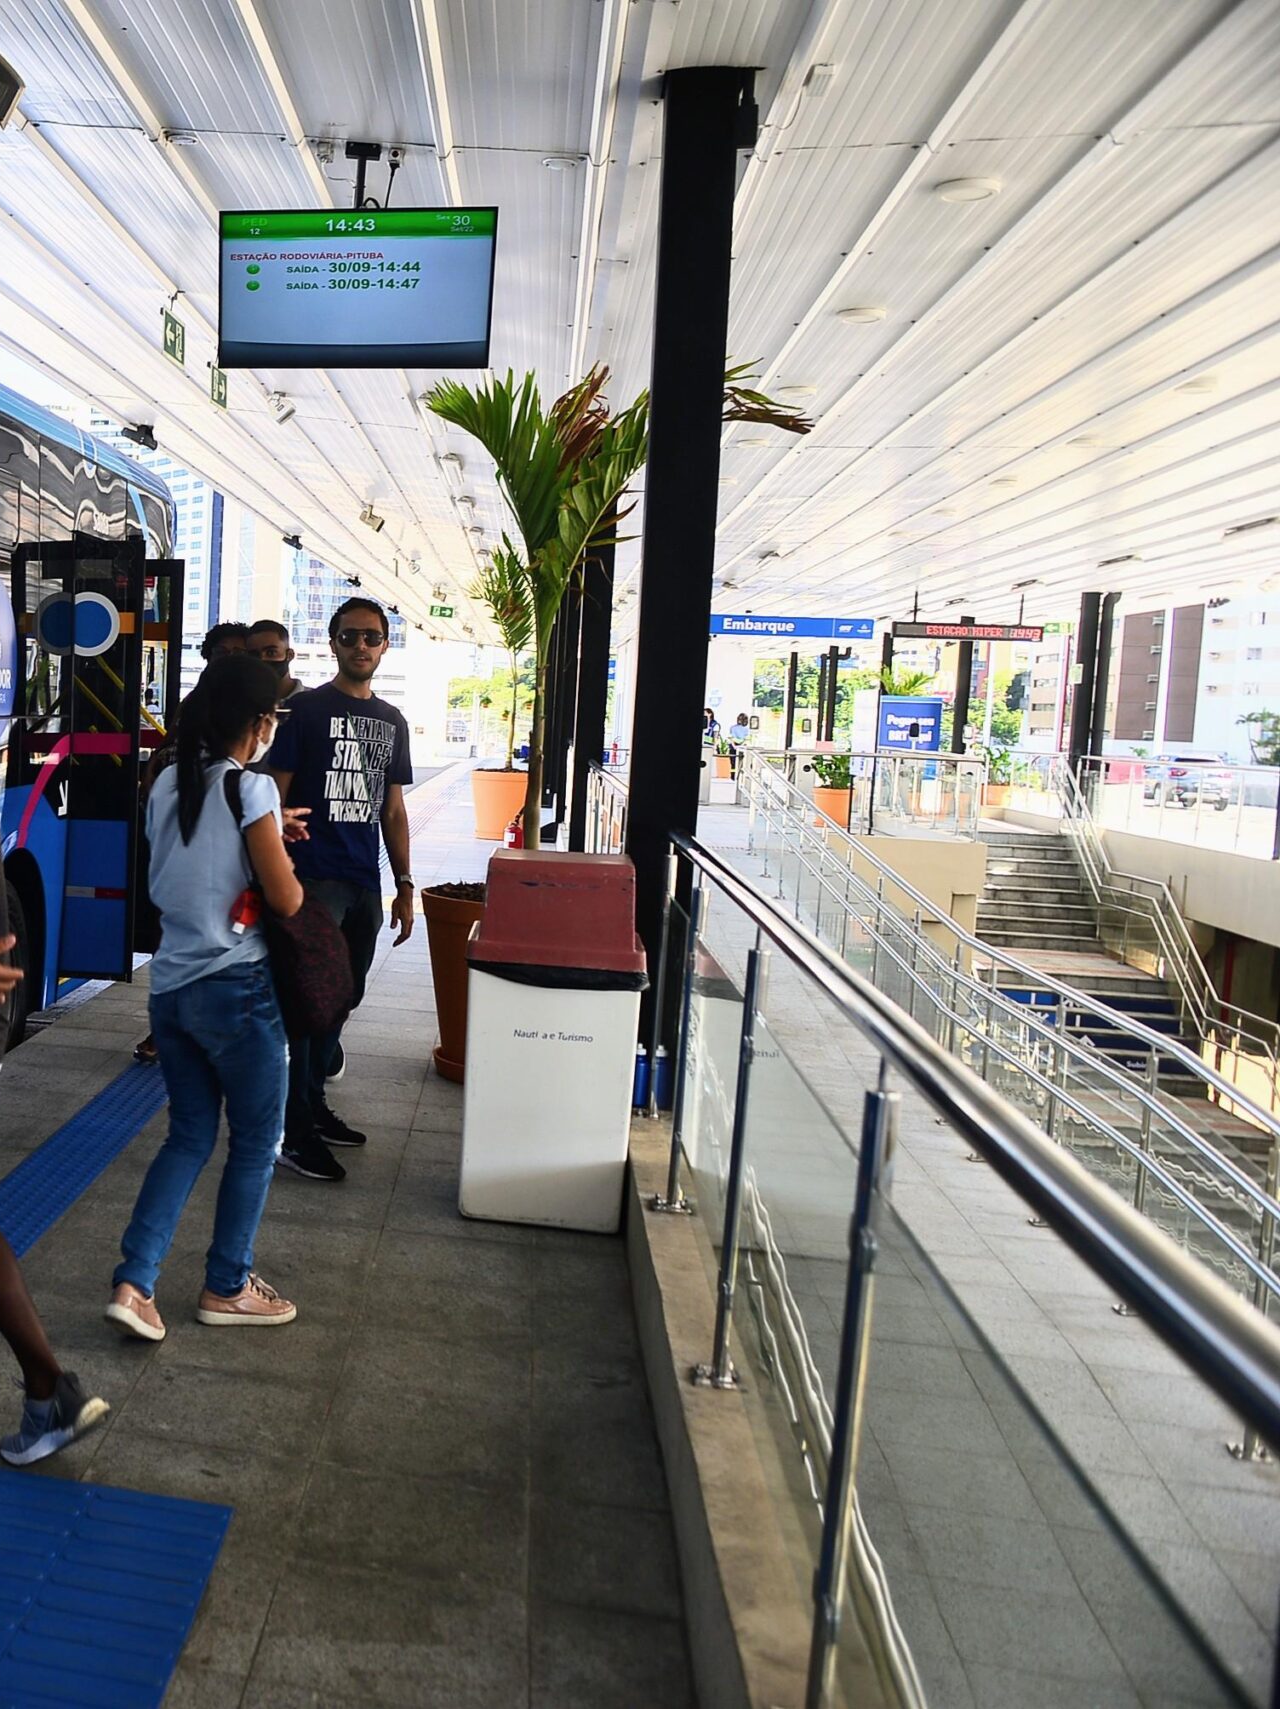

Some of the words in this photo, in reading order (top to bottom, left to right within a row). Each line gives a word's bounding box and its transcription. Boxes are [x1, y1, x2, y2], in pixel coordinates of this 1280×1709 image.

[241, 217, 268, 227] PED
[325, 219, 376, 232] 14:43
[452, 215, 471, 226] 30
[249, 227, 261, 235] 12
[230, 252, 278, 262] ESTAÇÃO
[280, 251, 384, 261] RODOVIÁRIA-PITUBA
[286, 264, 320, 274] SAÍDA
[328, 261, 421, 274] 30/09-14:44
[285, 281, 320, 291] SAÍDA
[328, 278, 420, 290] 30/09-14:47
[722, 617, 795, 634] Embarque
[329, 716, 345, 738] BE
[323, 770, 353, 799] THAN
[513, 1029, 548, 1040] Nautia
[558, 1031, 594, 1043] Turismo
